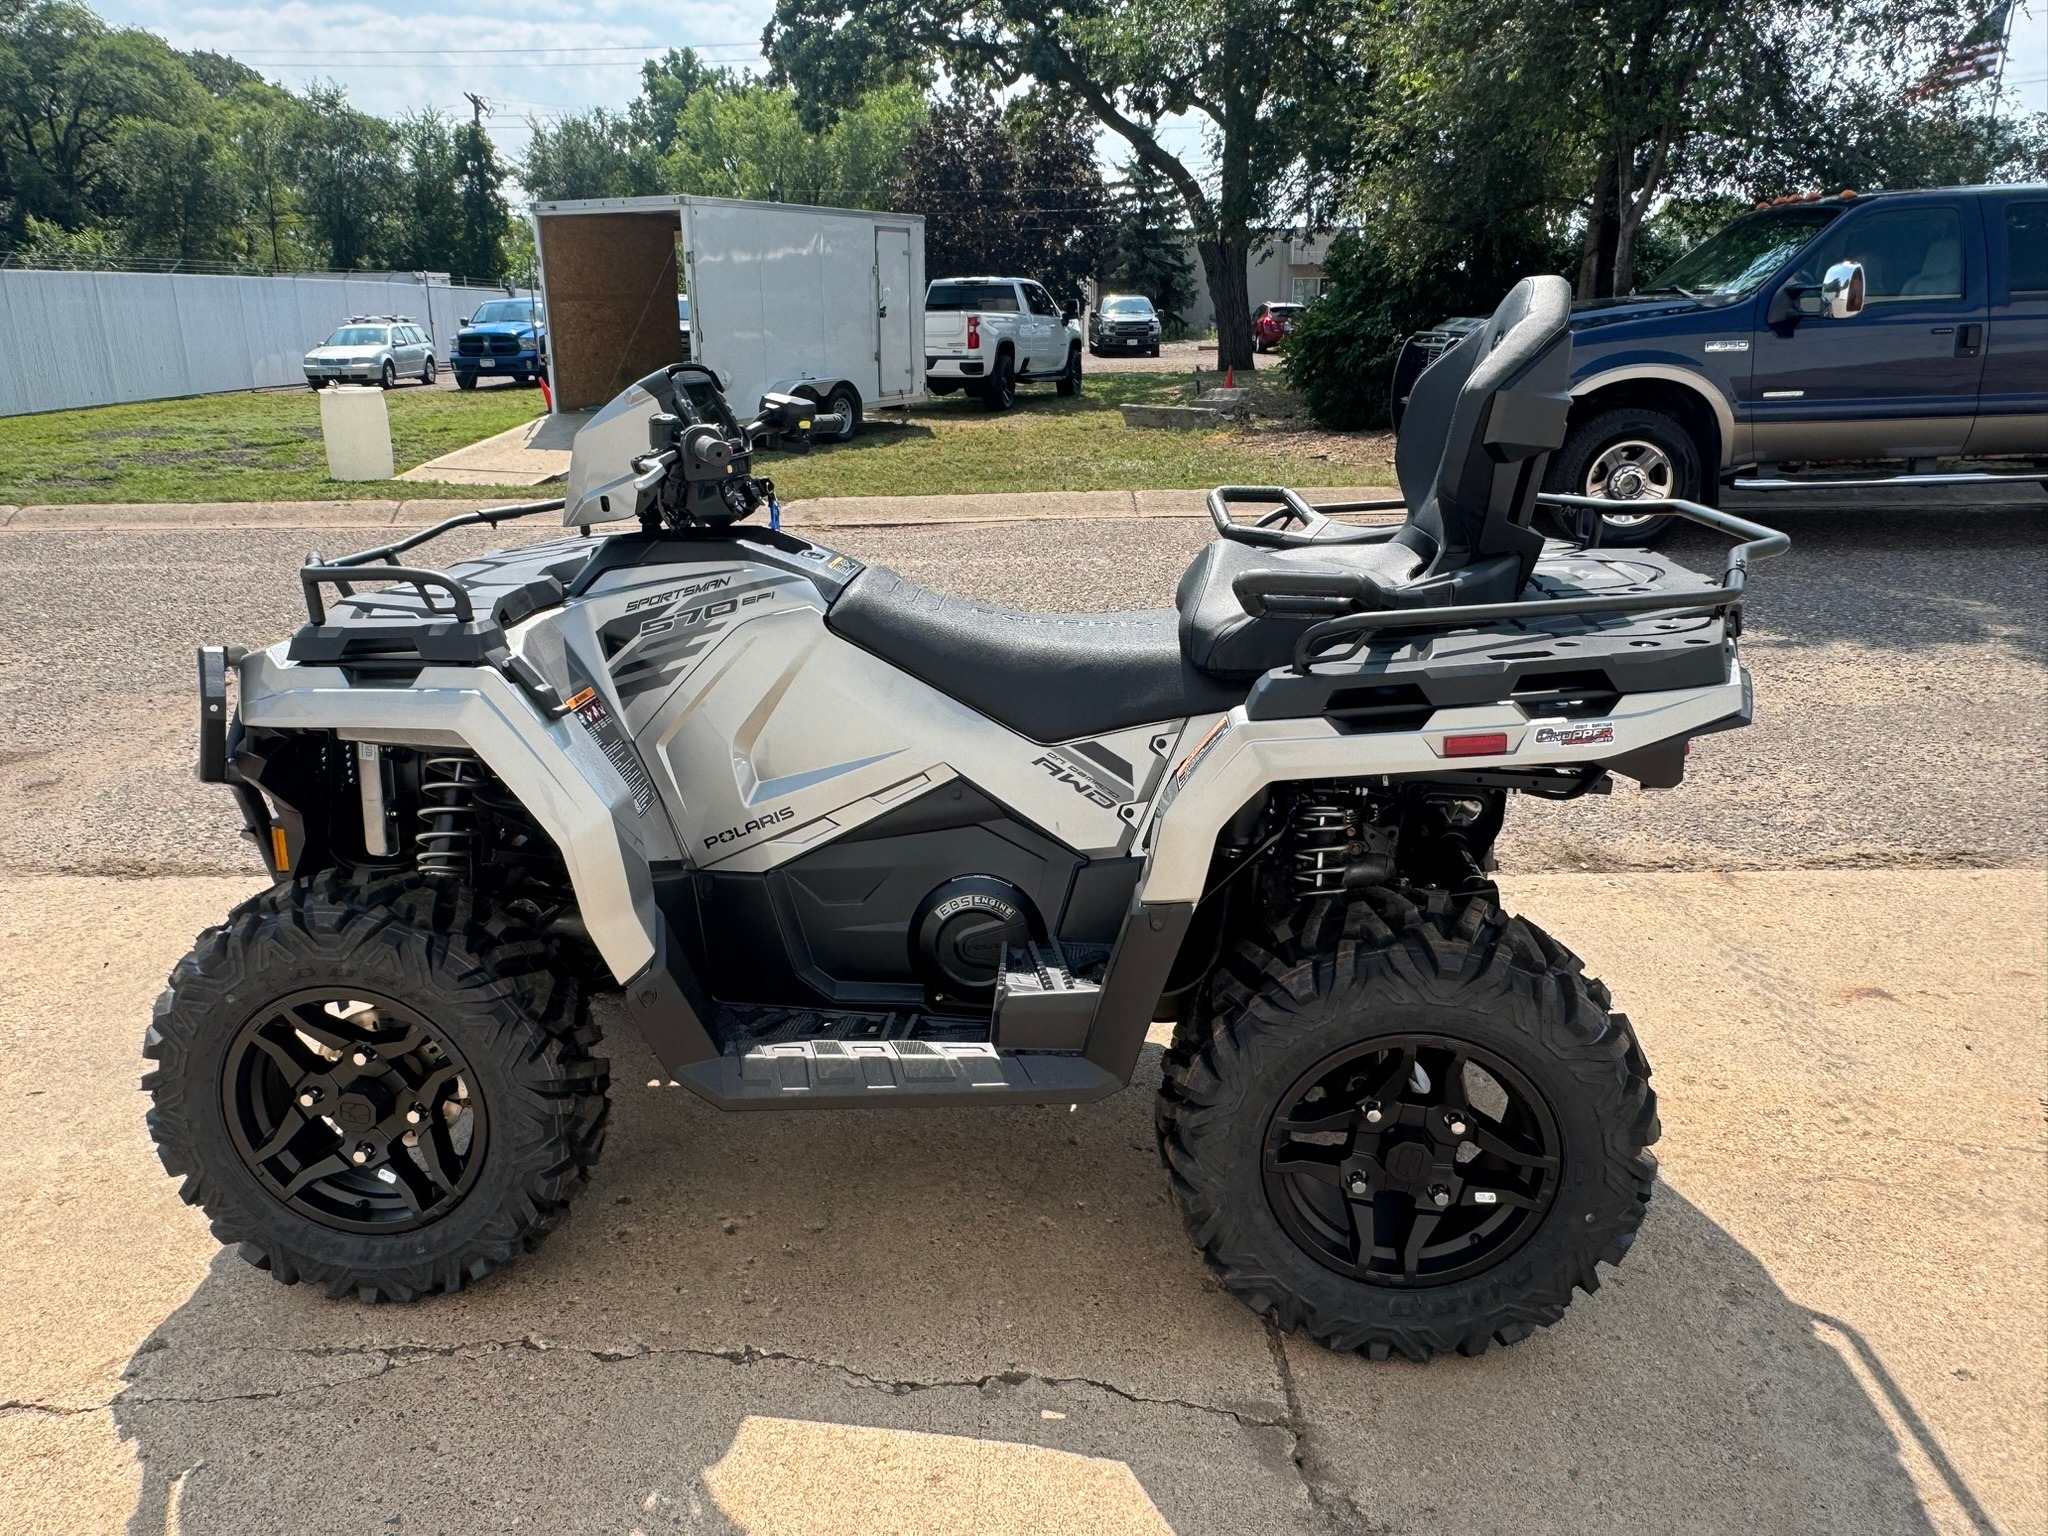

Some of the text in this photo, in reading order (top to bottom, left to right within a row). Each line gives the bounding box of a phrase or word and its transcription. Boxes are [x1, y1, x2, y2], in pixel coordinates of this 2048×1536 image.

[625, 576, 731, 612] SPORTSMAN
[640, 598, 738, 637] 570
[1031, 757, 1117, 809] AWD
[704, 806, 794, 849] POLARIS
[940, 895, 1014, 917] EBS ENGINE
